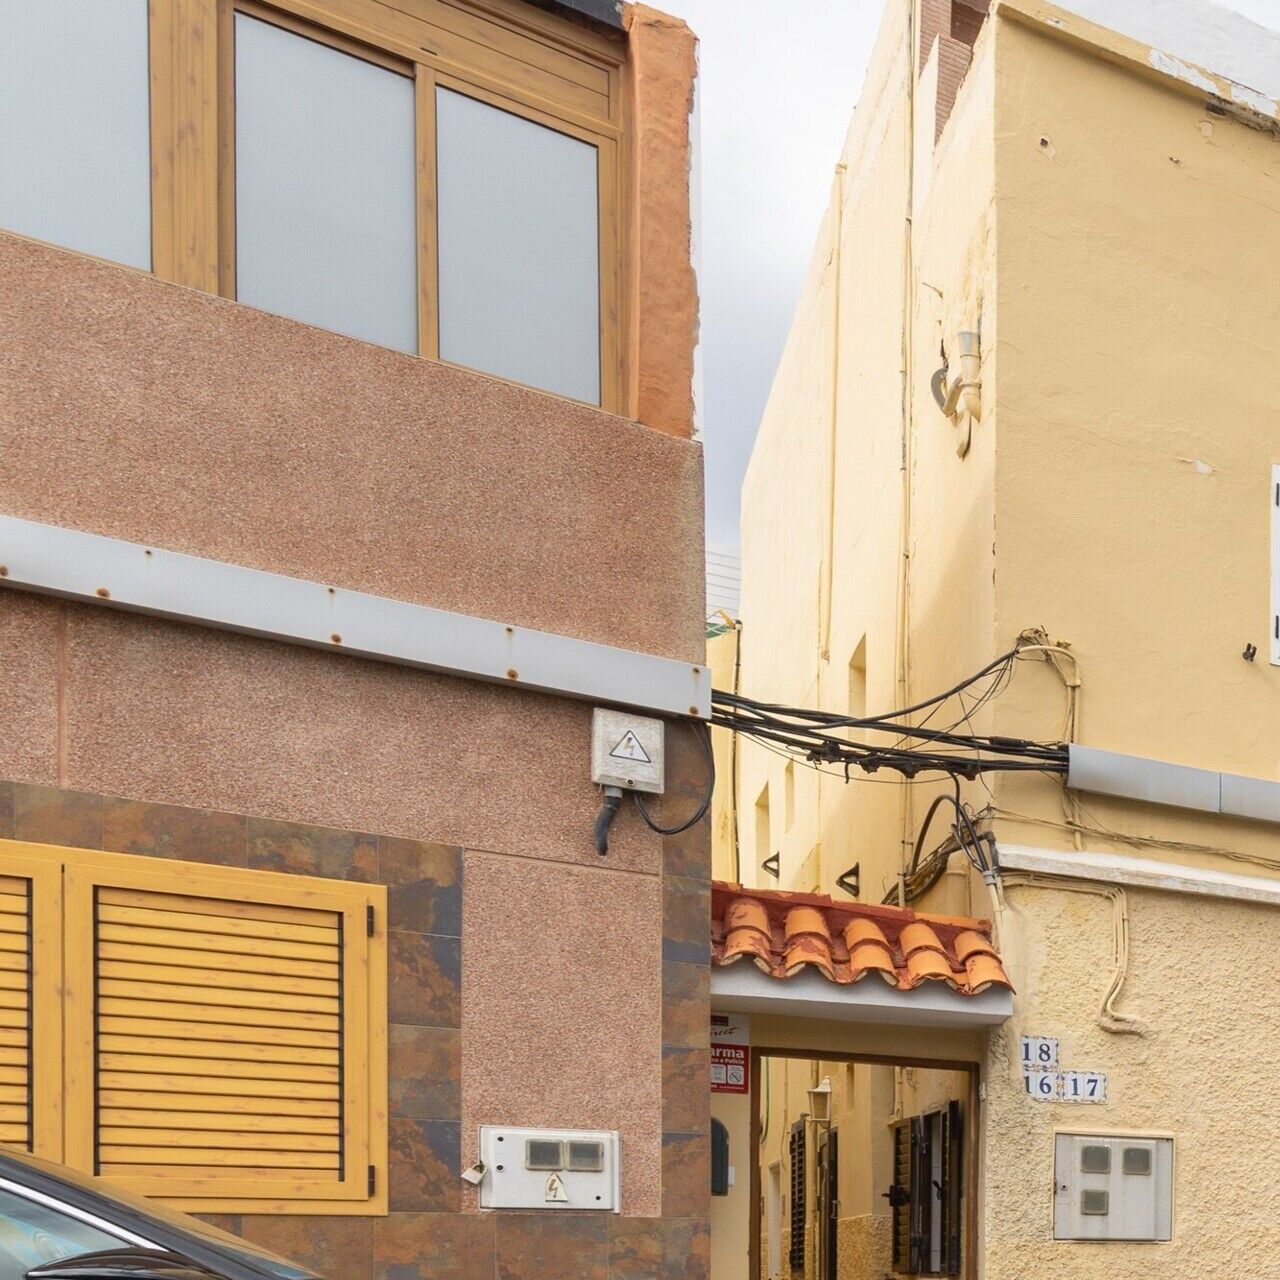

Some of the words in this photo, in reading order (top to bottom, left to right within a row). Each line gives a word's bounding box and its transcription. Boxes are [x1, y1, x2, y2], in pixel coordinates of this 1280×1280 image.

[1022, 1042, 1051, 1062] 18
[1024, 1075, 1052, 1095] 16
[1071, 1077, 1099, 1097] 17
